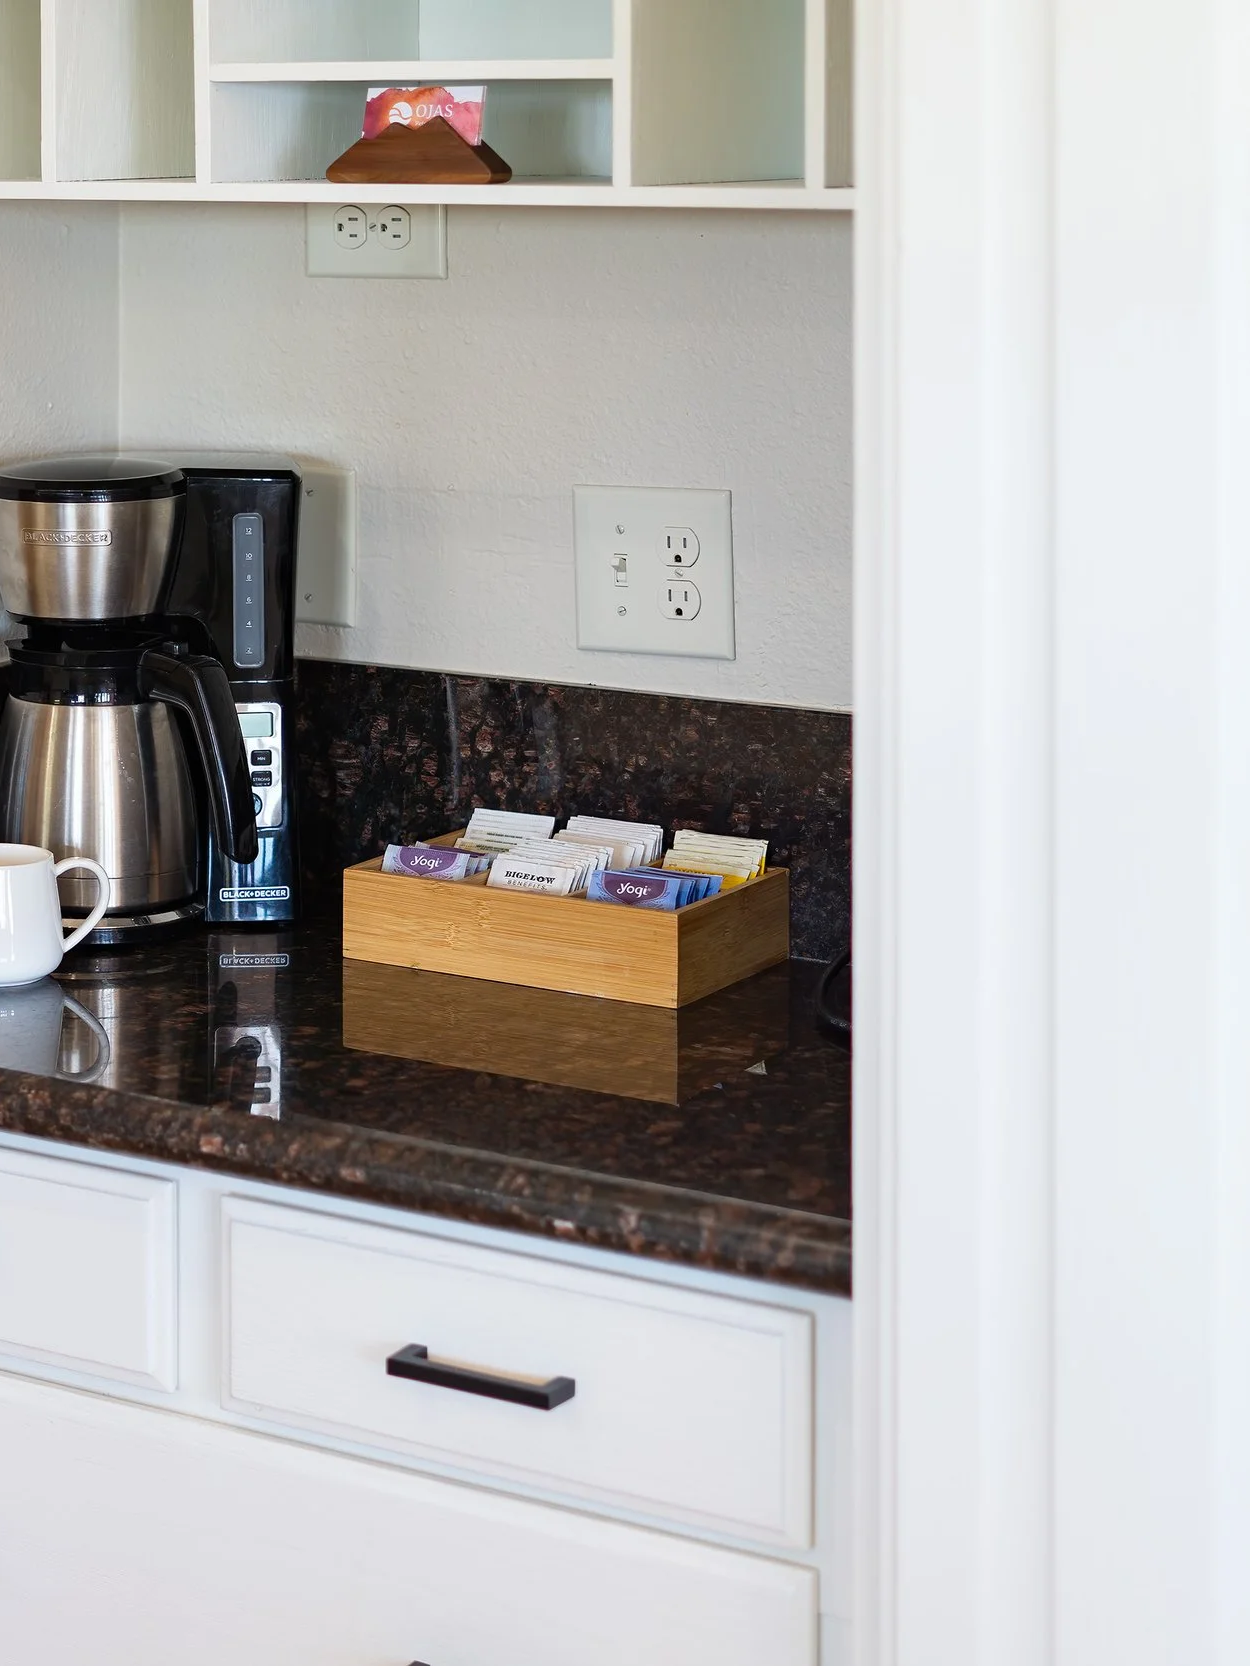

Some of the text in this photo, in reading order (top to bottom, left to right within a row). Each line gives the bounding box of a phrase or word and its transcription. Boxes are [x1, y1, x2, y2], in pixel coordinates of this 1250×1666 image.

[416, 104, 454, 119] OJAS
[504, 871, 556, 884] BIGELOW
[507, 880, 547, 891] BENEFITS
[222, 890, 287, 899] BLACK+DECKER
